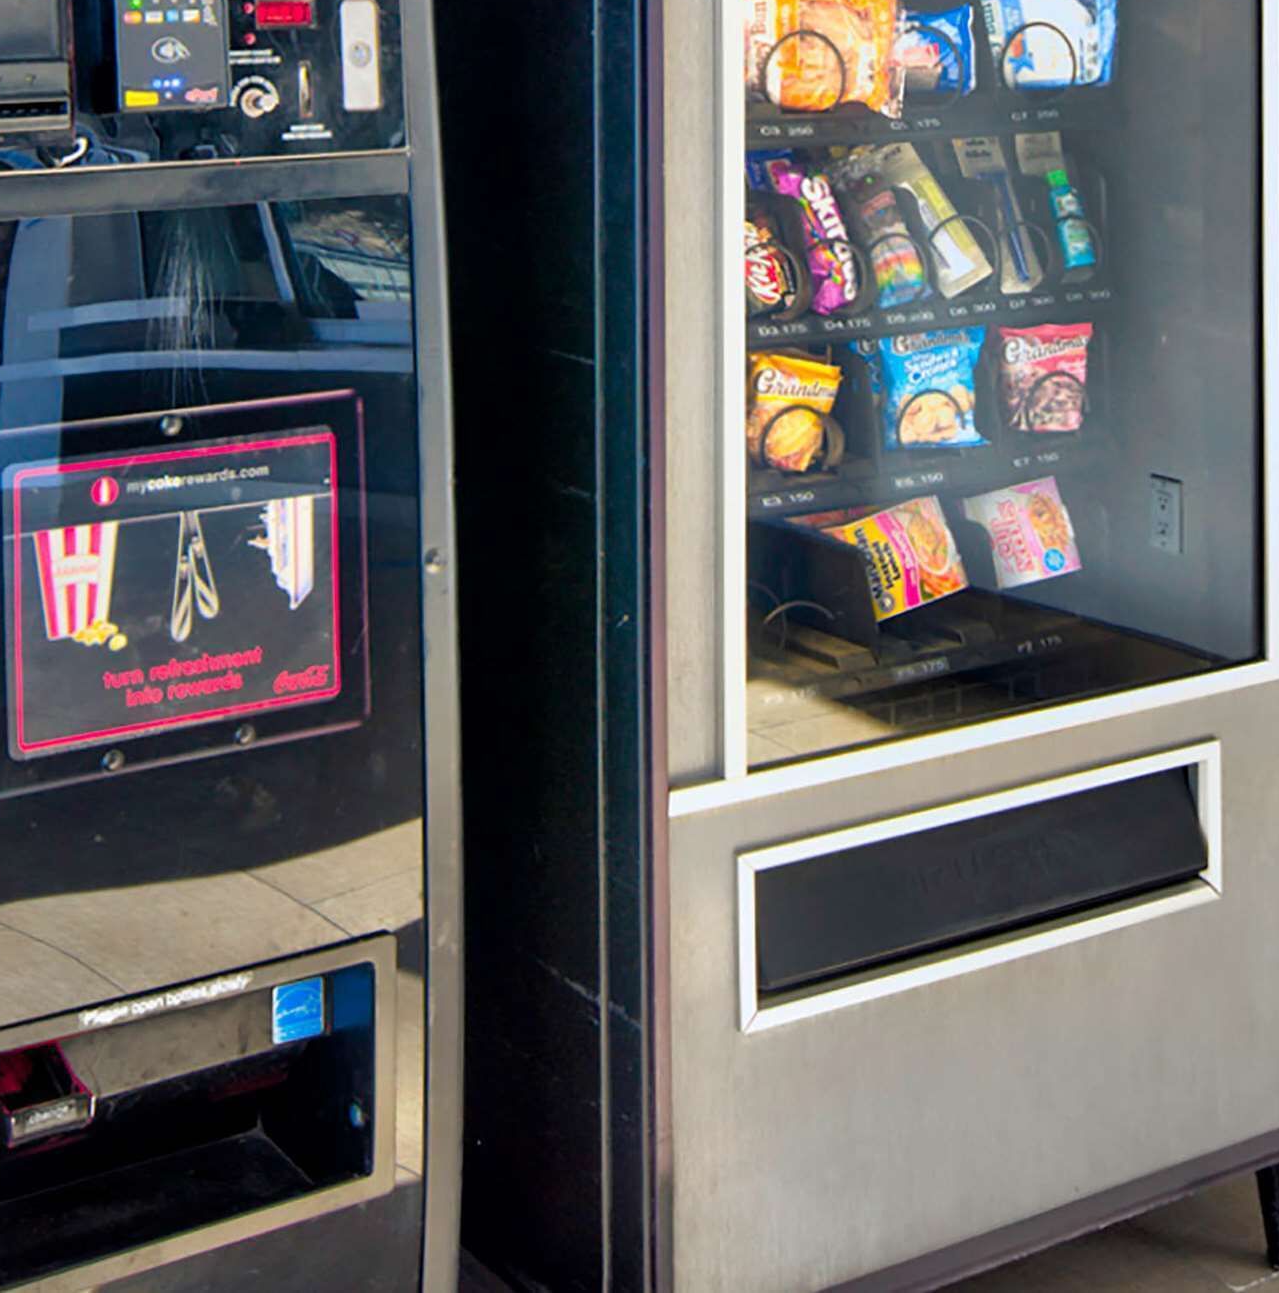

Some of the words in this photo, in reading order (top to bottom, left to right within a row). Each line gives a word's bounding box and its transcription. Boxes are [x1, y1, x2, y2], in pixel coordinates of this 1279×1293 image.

[126, 465, 270, 495] mycokerewards.com
[102, 669, 144, 688] turn
[149, 647, 263, 681] refreshment
[126, 683, 163, 707] into
[167, 671, 244, 699] rewards
